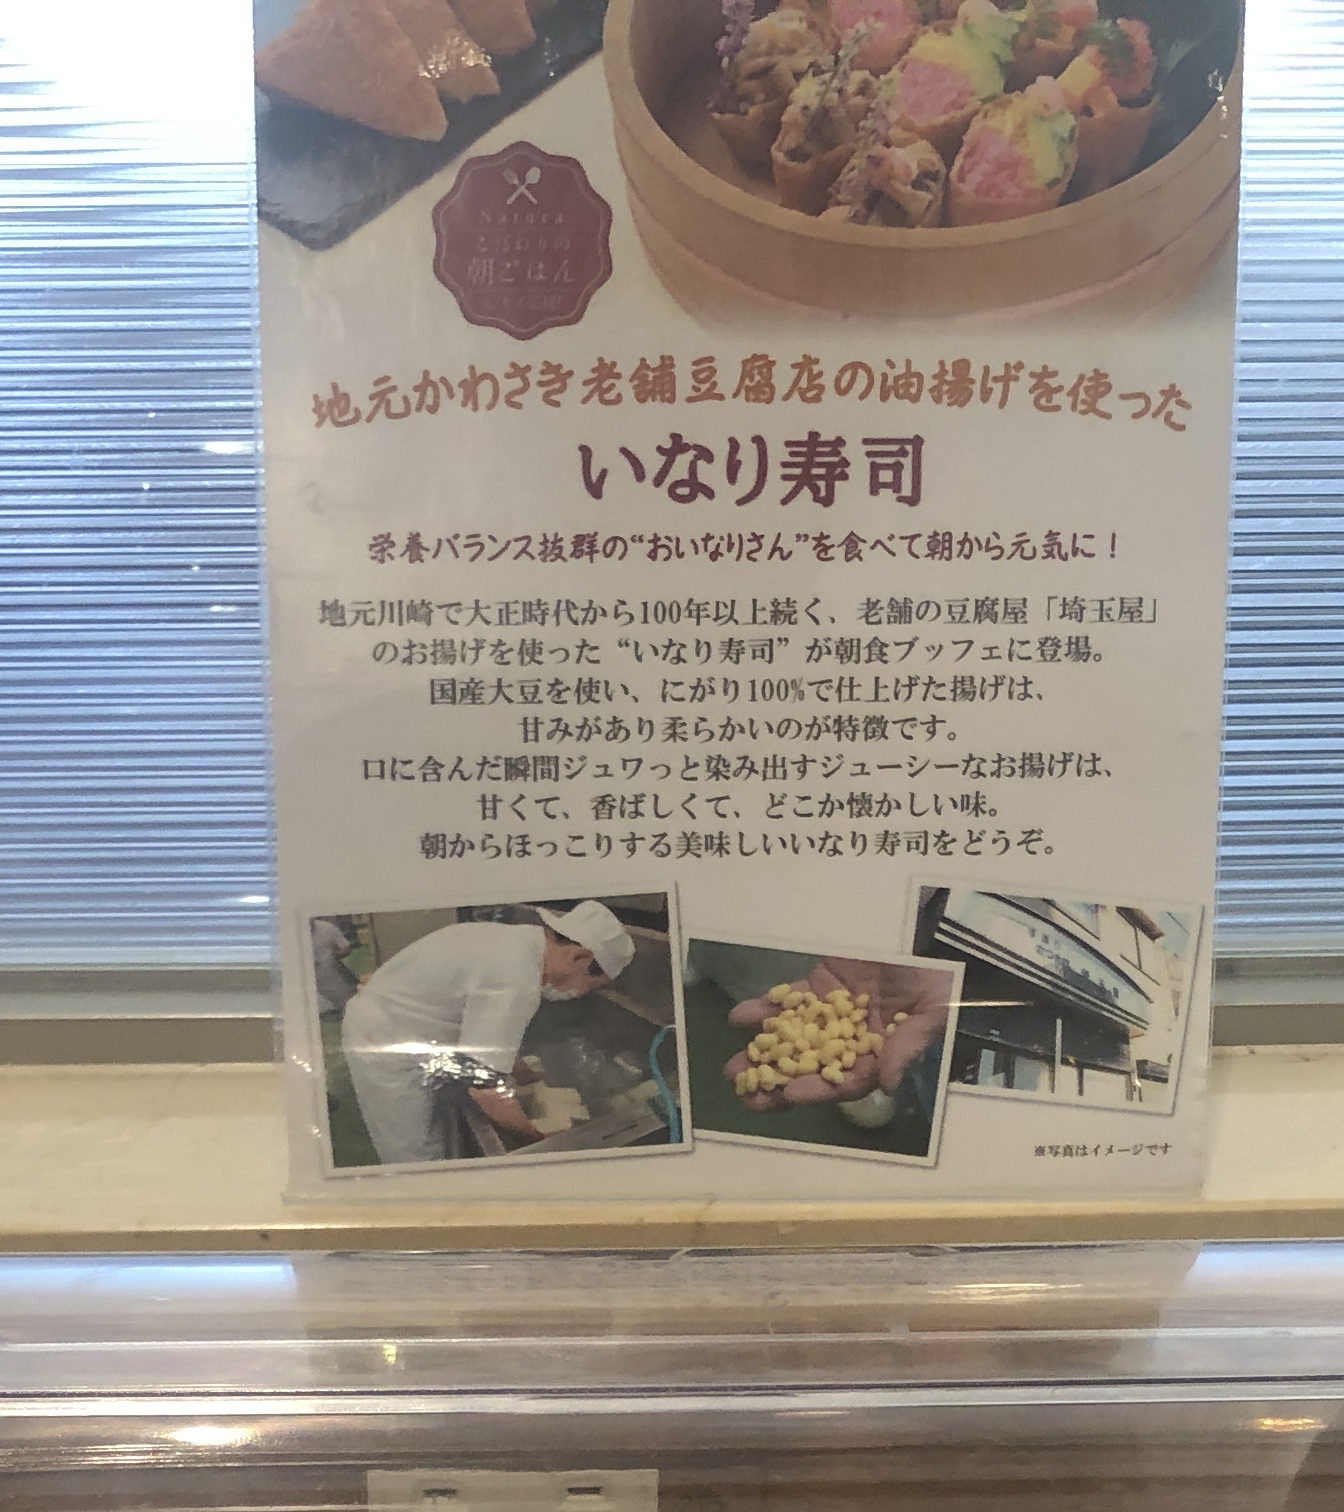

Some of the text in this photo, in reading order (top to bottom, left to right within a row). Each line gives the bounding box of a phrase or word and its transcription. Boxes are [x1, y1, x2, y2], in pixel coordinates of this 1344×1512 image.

[466, 257, 576, 287] 朝ごはん
[310, 353, 1193, 432] 地元かわさき老舗豆腐店の油揚げを使った
[577, 430, 925, 507] いなり寿司
[317, 596, 1158, 629] 地元川崎で大正時代から100年以上続く、老舗の豆腐屋「埼玉屋」
[428, 674, 1045, 706] 国産大豆を使い、にがり100%で仕上げた揚げは、
[518, 714, 959, 744] 甘みがあり柔らかいのが特徴です。
[361, 752, 1114, 783] 口に含んだ瞬間ジュワっと染み出すジューシーなお揚げは、
[476, 791, 1000, 822] 甘くて、香ばしくて、どこか懐かしい味。
[418, 828, 1055, 860] 朝からほっこりする美味しいいなり寿司をどうぞ。
[1033, 1142, 1173, 1158] ※写真はイメージです
